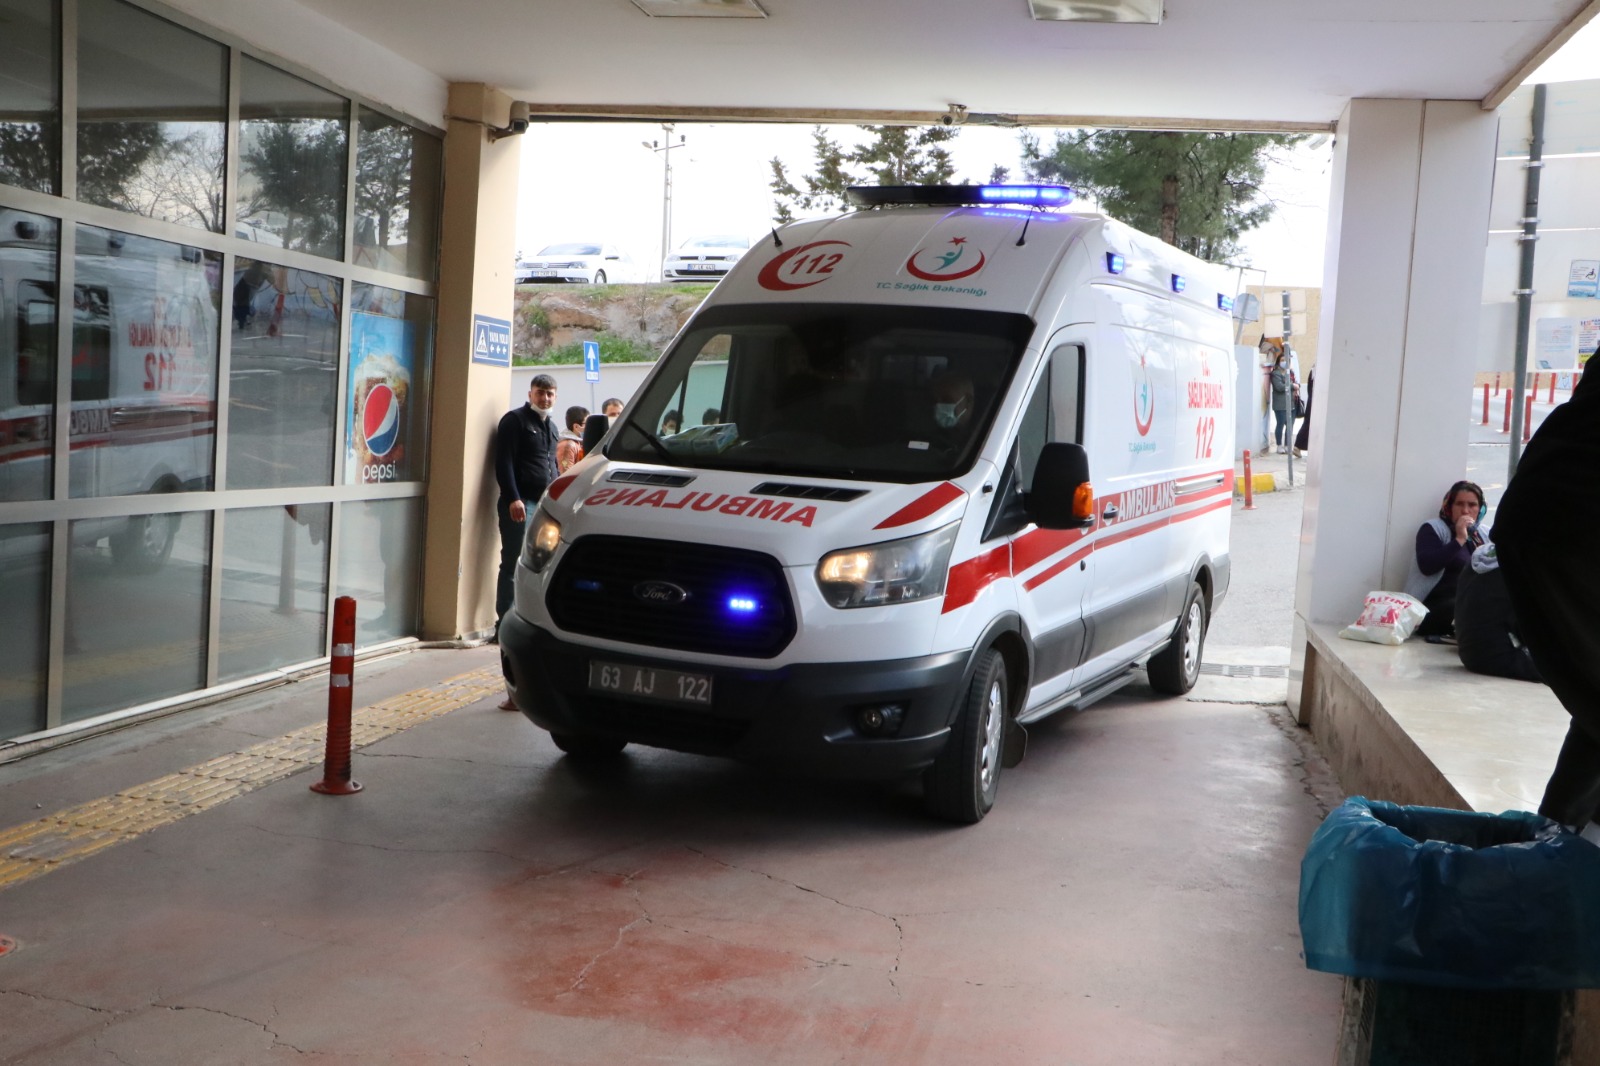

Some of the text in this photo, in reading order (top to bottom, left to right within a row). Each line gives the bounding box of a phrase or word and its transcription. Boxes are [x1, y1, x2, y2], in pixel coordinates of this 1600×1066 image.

[789, 253, 844, 275] 112
[1195, 416, 1215, 459] 112
[362, 460, 396, 484] pepsi
[1117, 480, 1176, 522] AMBULANS
[642, 586, 673, 600] Ford
[601, 665, 709, 701] 63 AJ 122
